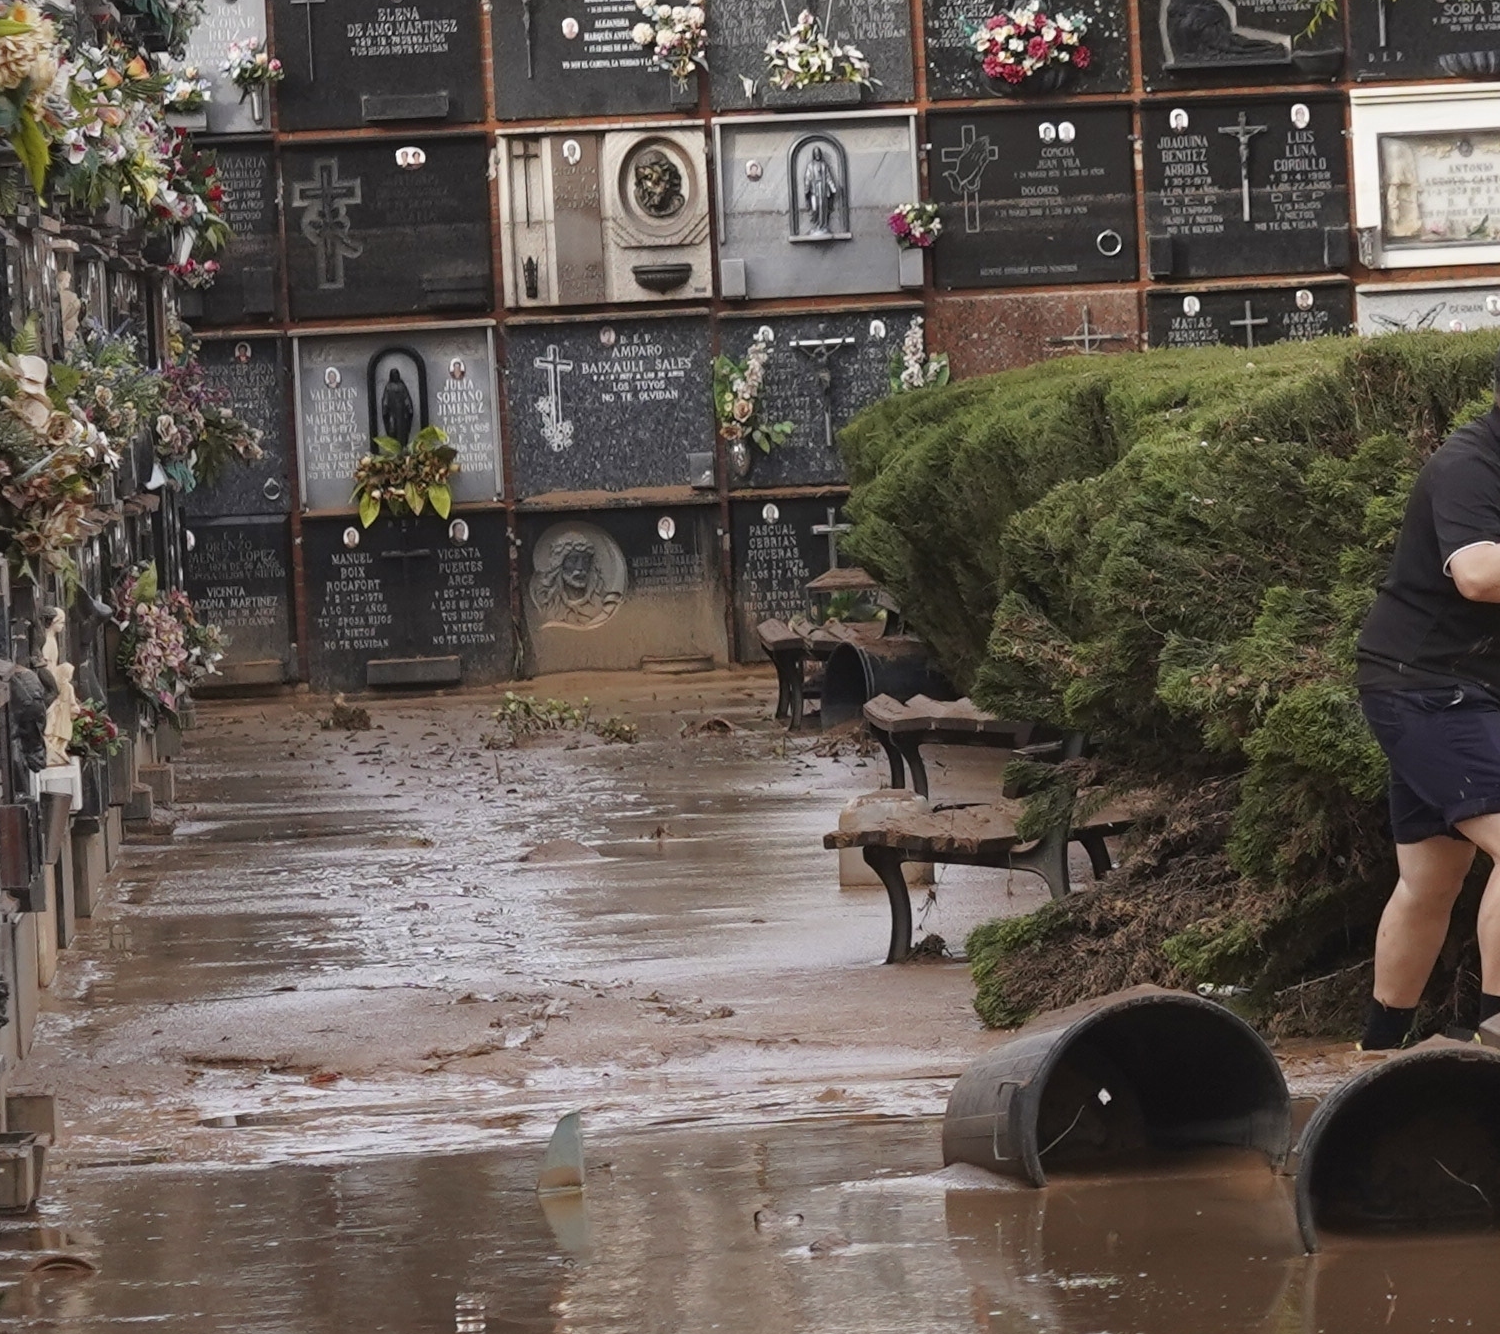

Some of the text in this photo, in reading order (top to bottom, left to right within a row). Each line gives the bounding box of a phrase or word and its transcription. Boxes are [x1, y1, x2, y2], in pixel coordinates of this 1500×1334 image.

[377, 6, 420, 22] ELENA
[1443, 2, 1485, 16] SORIA
[346, 23, 362, 38] DE
[366, 22, 394, 37] AMO
[1157, 135, 1209, 149] JOAQUINA
[1287, 131, 1315, 144] LUIS
[1161, 148, 1207, 163] BENITEZ
[1285, 144, 1318, 158] LUNA
[611, 344, 662, 358] AMPARO
[581, 357, 692, 374] BAIXAULI SALES
[443, 378, 474, 391] JULIA
[436, 390, 483, 403] SORIANO
[602, 389, 679, 403] NO TE OLVIDAN
[437, 402, 484, 416] JIMENEZ
[749, 524, 796, 536] PASCUAL
[331, 553, 373, 566] MANUEL
[438, 548, 481, 559] VICENTA
[747, 547, 799, 561] PIQUERAS
[340, 566, 366, 579] BOIX
[326, 579, 381, 593] ROCAFORT
[447, 574, 475, 586] ARCE
[206, 586, 246, 598] VICENTA
